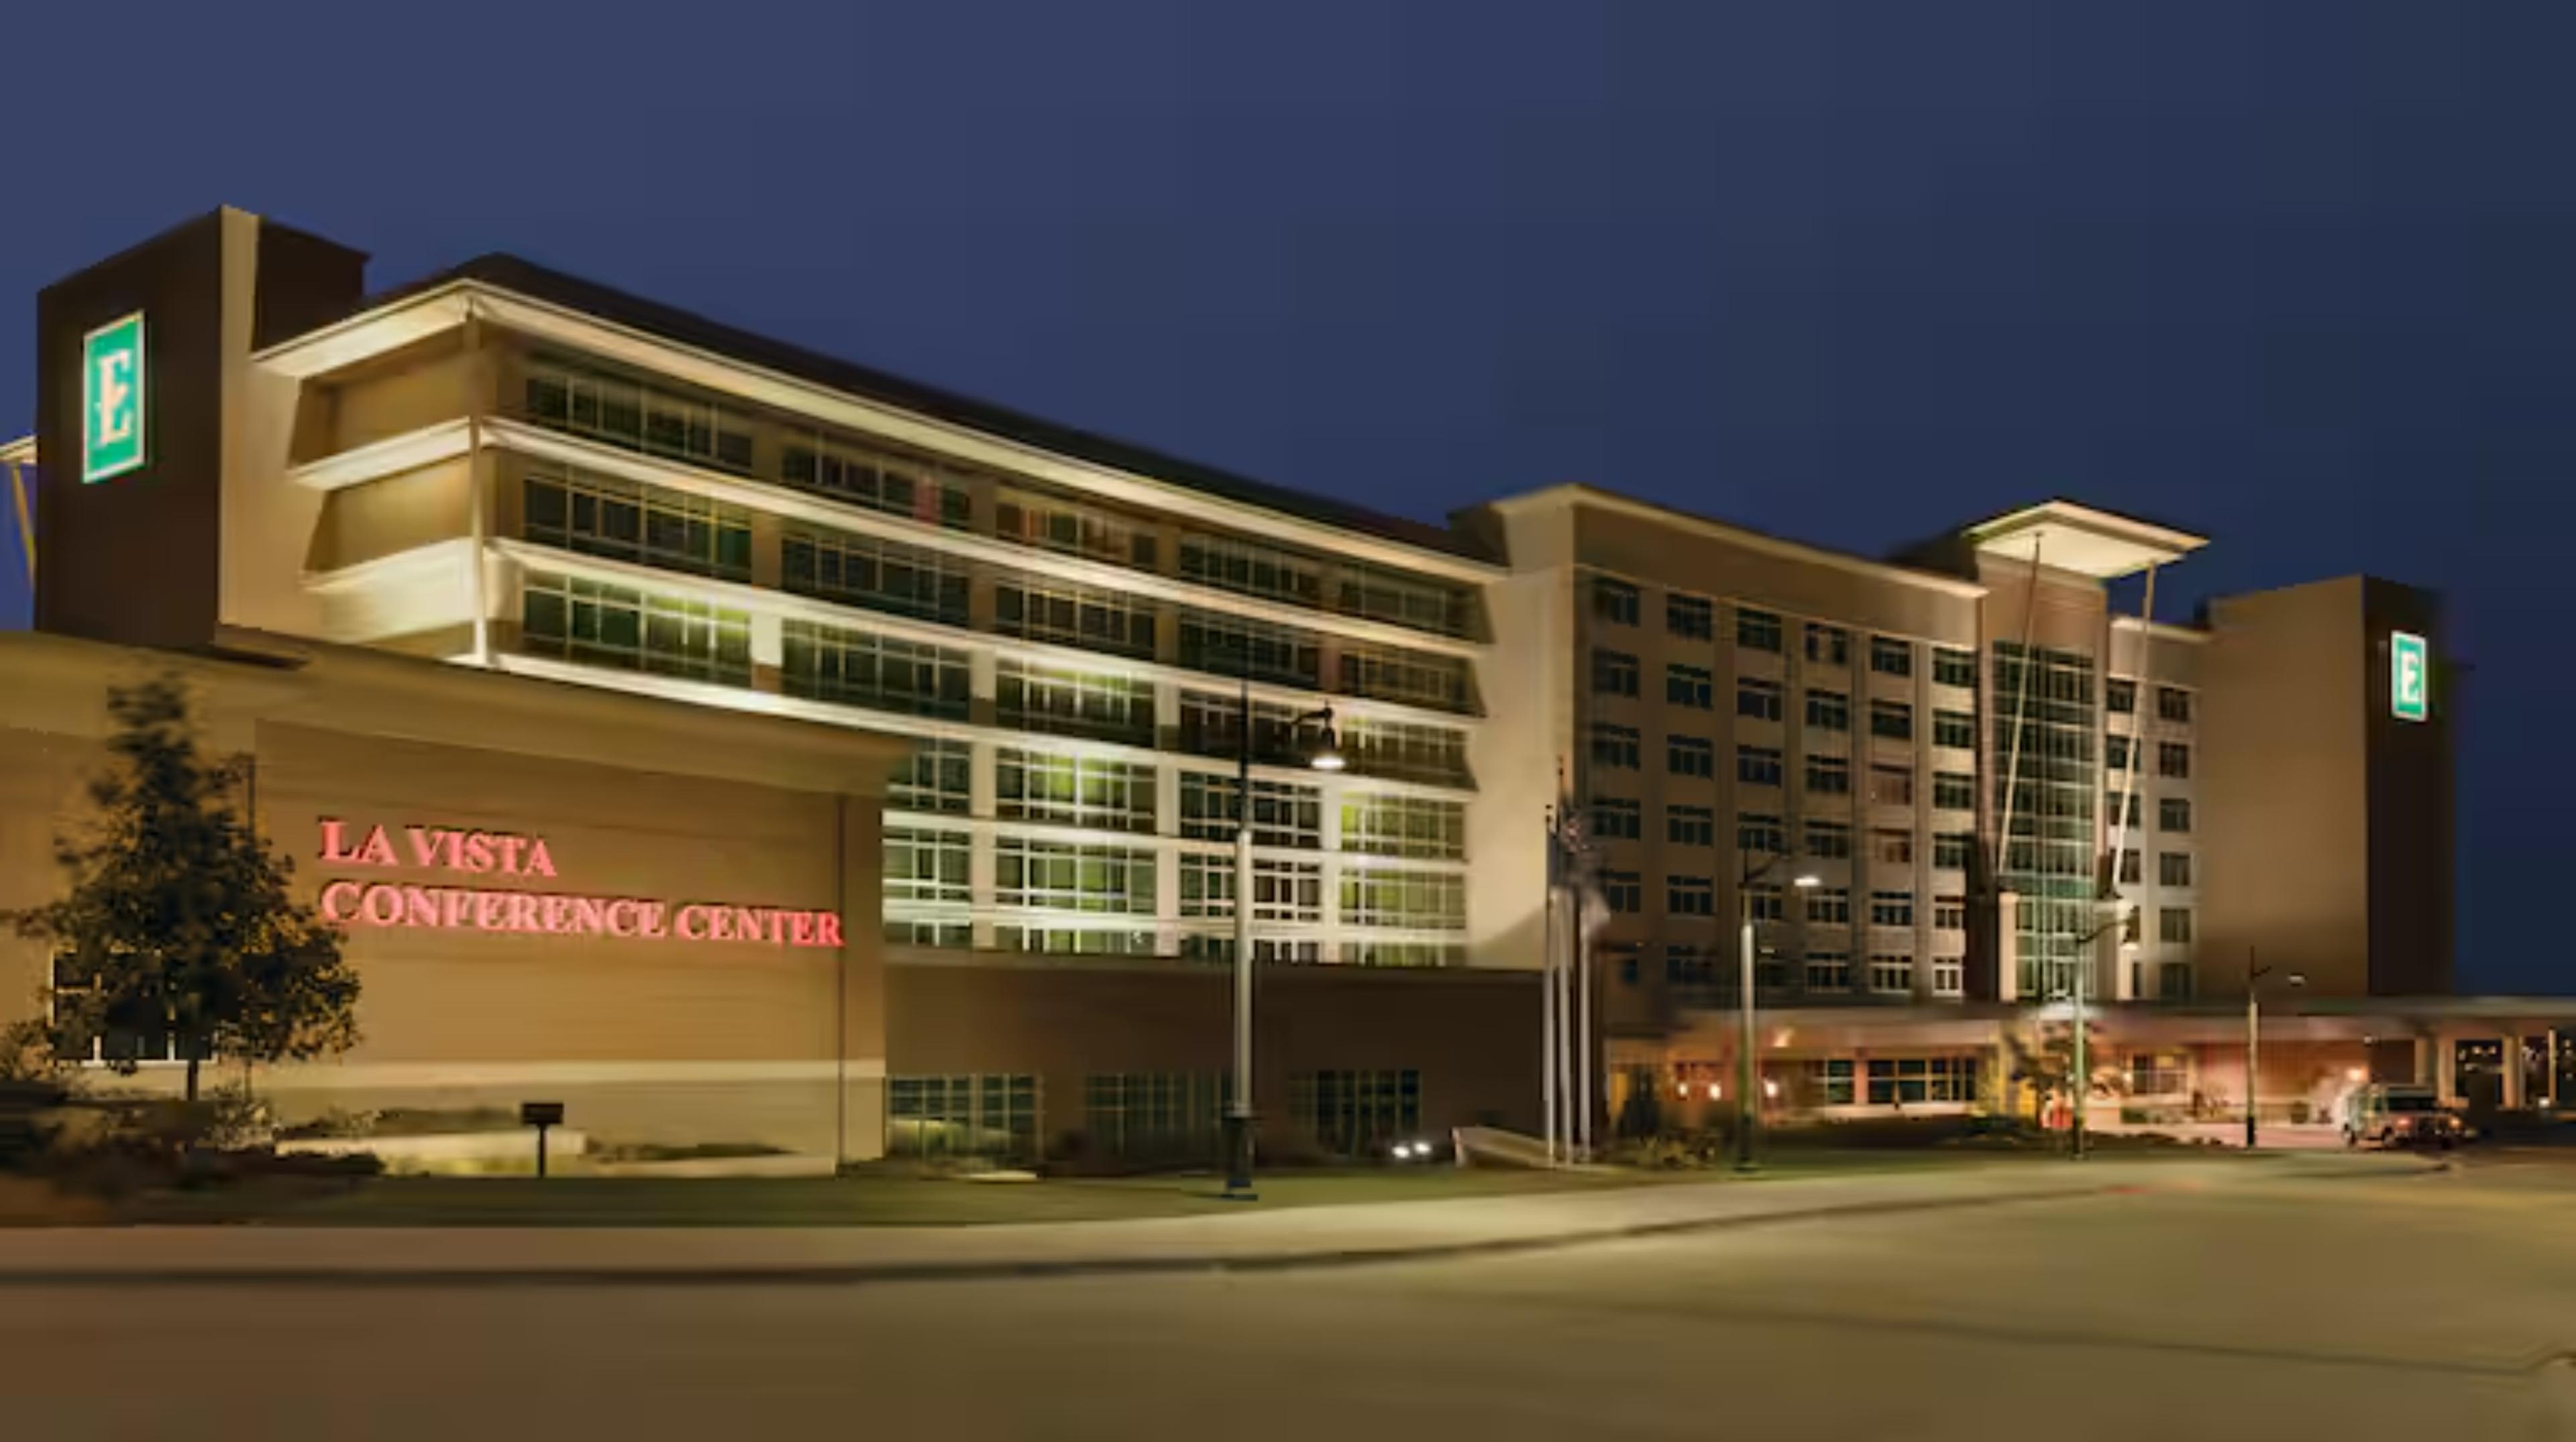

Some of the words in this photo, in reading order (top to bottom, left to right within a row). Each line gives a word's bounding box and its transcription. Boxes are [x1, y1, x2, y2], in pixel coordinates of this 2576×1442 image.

[94, 348, 132, 447] E
[2400, 651, 2420, 703] E
[318, 818, 398, 866] LA
[404, 827, 557, 877] VISTA
[319, 881, 667, 937] CONFERENCE
[674, 904, 844, 947] CENTER
